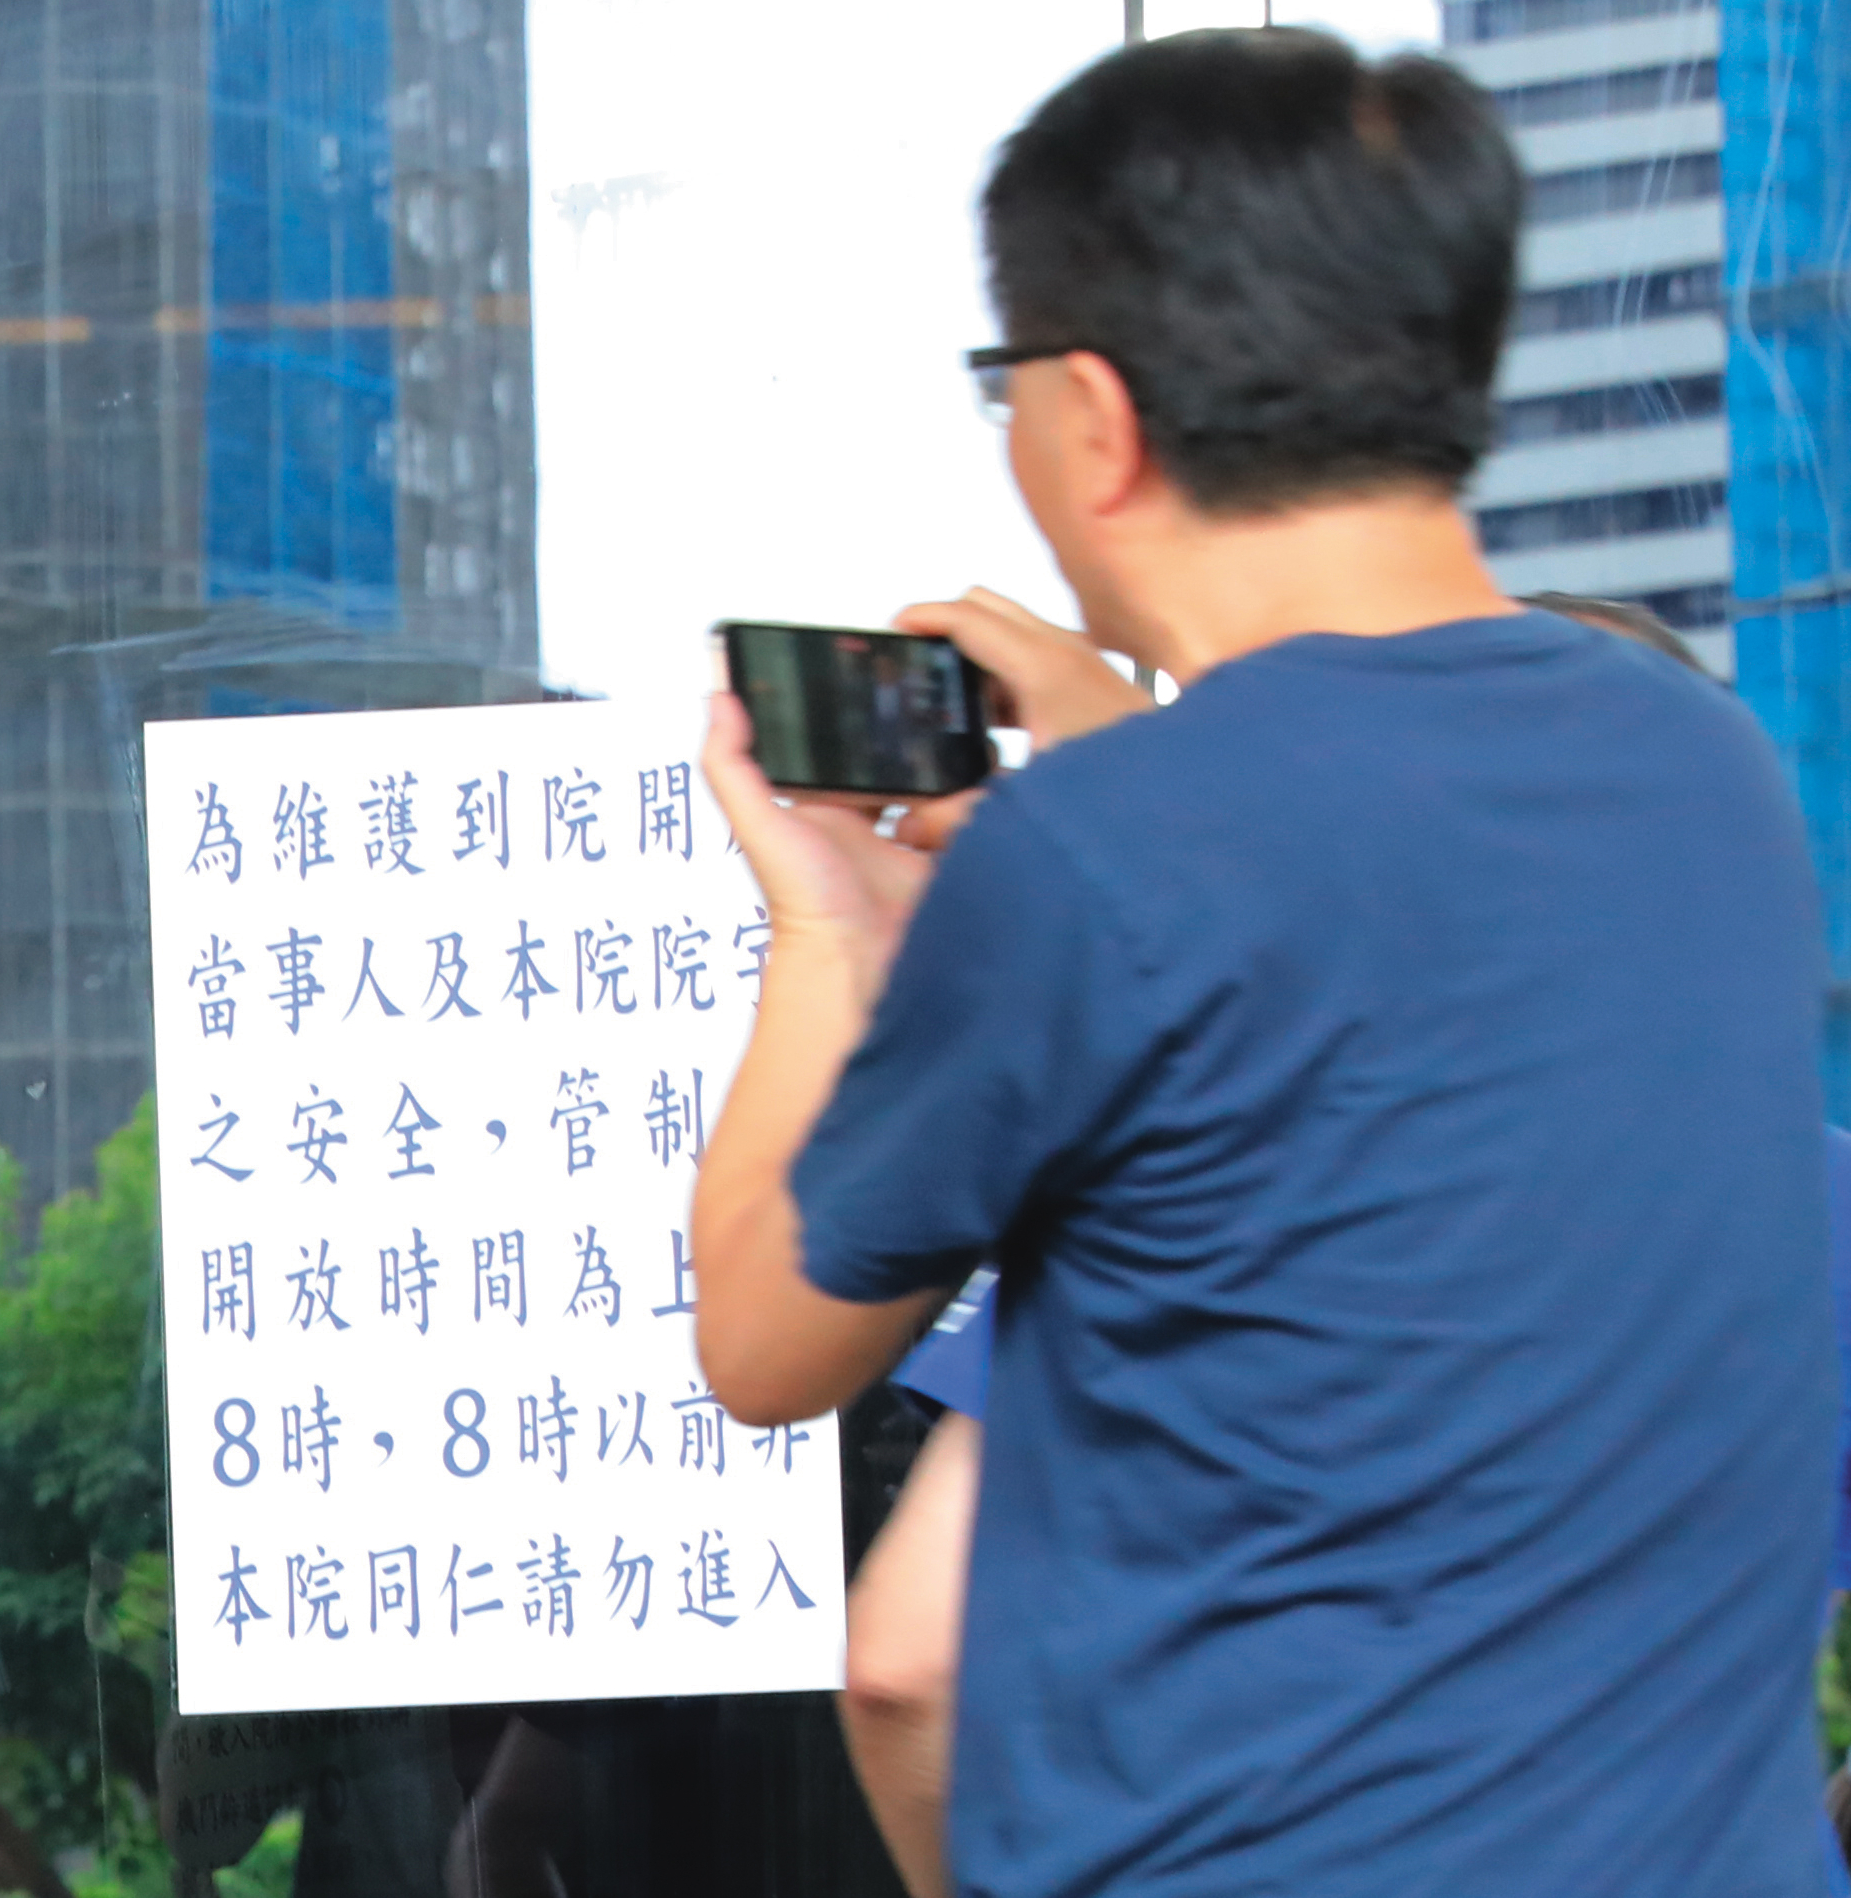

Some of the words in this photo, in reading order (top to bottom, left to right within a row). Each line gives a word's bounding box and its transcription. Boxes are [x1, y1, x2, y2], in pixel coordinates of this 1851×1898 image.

[185, 760, 744, 884] 為維護到院開
[213, 1527, 817, 1647] 本院同仁請勿進入
